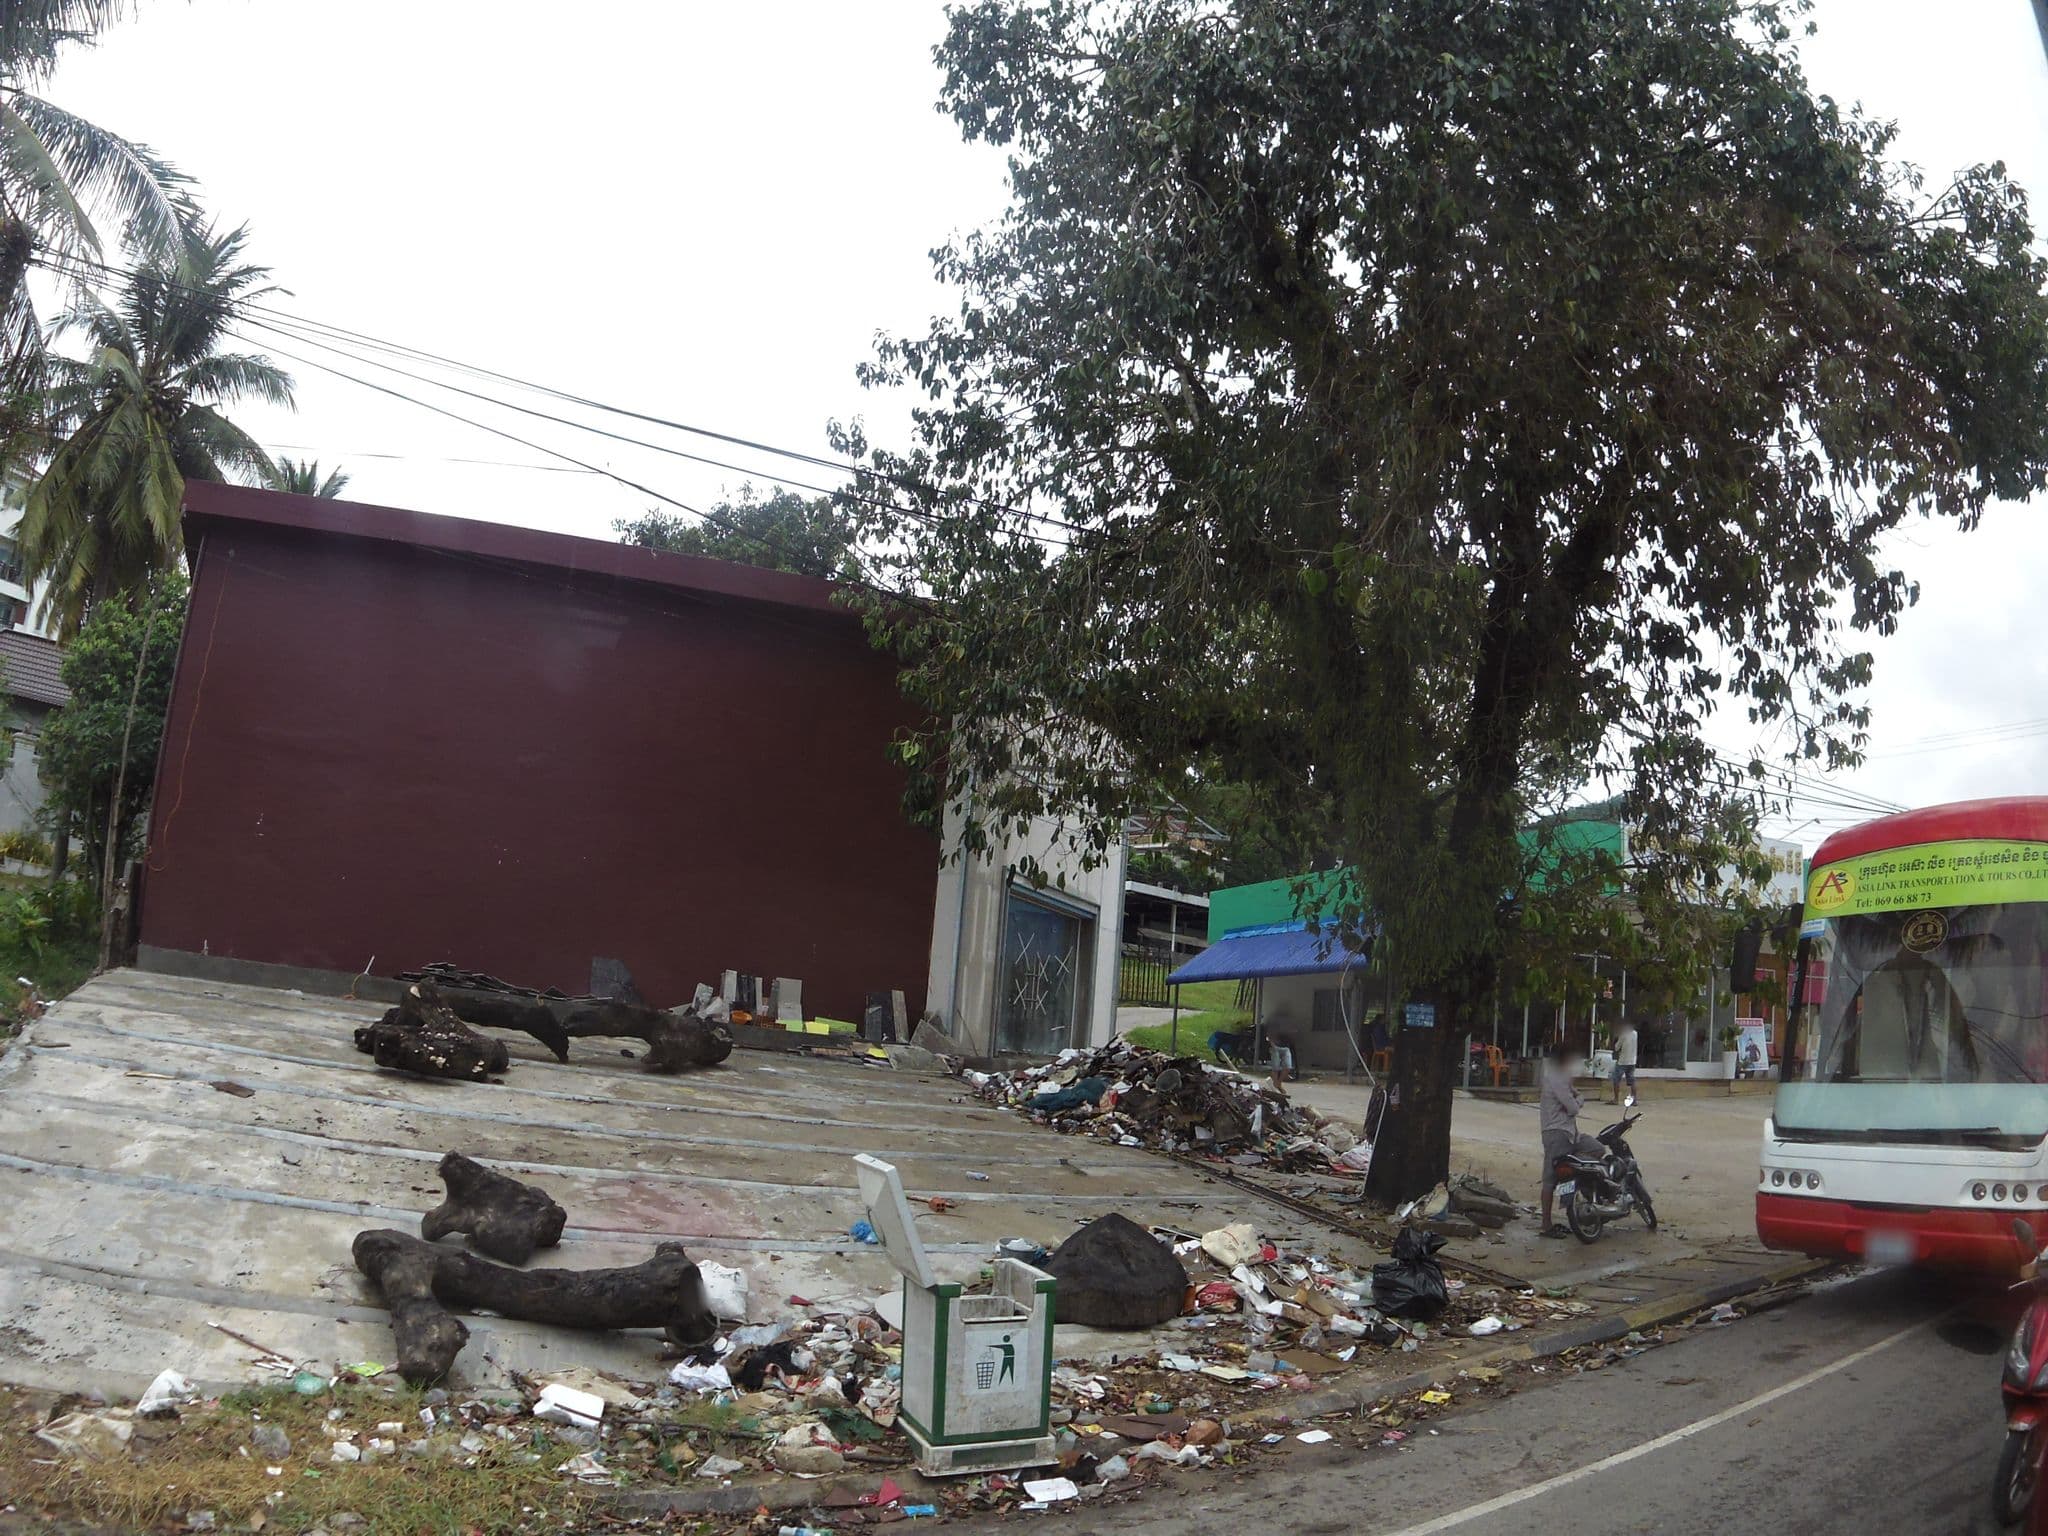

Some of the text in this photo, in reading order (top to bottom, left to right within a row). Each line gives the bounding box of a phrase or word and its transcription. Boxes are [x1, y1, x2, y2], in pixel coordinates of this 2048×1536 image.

[1857, 884, 1875, 894] ASIA
[1876, 881, 1897, 892] LINK
[1899, 874, 1976, 889] TRANSPORTATION
[1978, 873, 1985, 883] &
[1988, 871, 2017, 881] TOURS
[1855, 892, 1932, 908] Tel: 069 66 88 73
